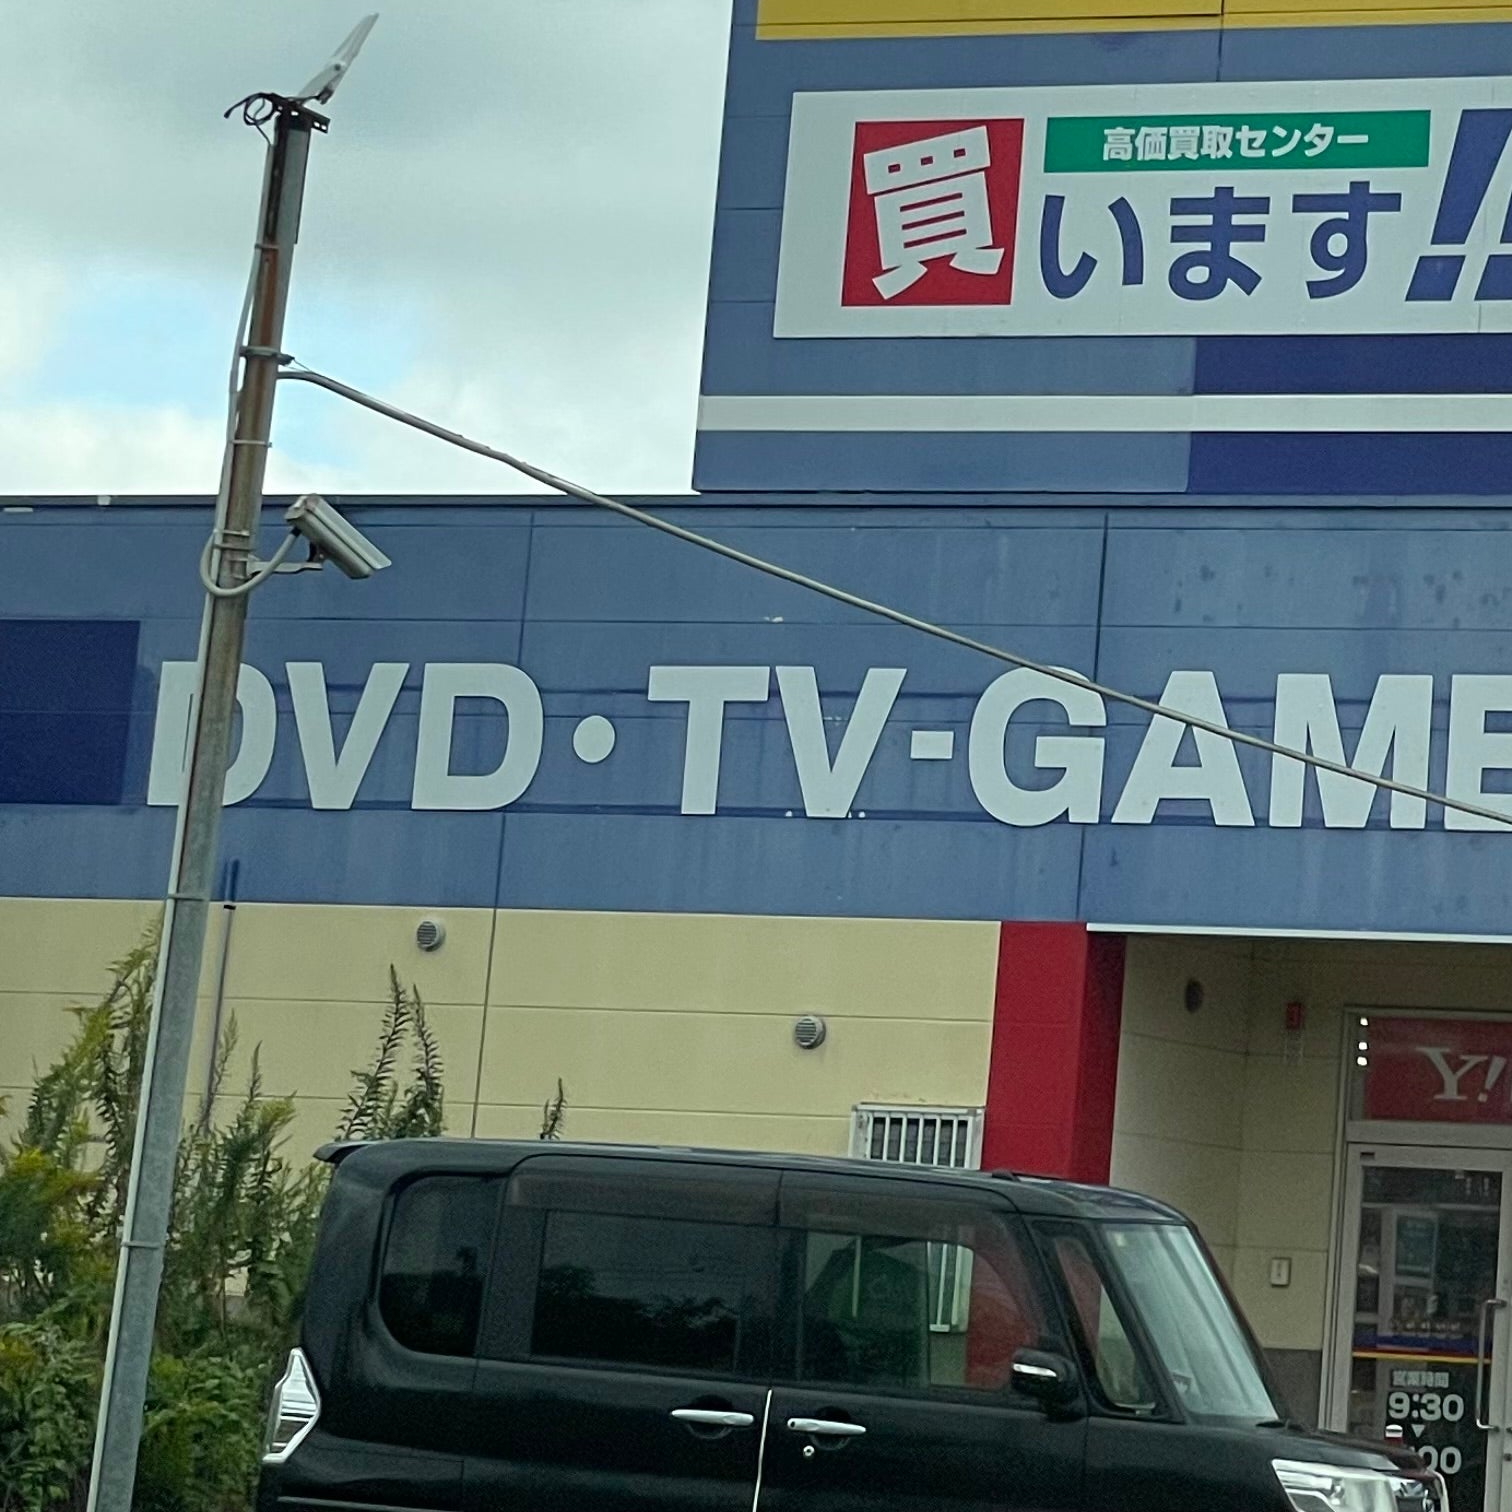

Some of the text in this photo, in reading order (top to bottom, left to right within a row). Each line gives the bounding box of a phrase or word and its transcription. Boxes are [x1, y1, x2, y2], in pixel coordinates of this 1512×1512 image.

[1102, 123, 1369, 161] 高価買取センター
[1388, 1392, 1465, 1422] 9:30
